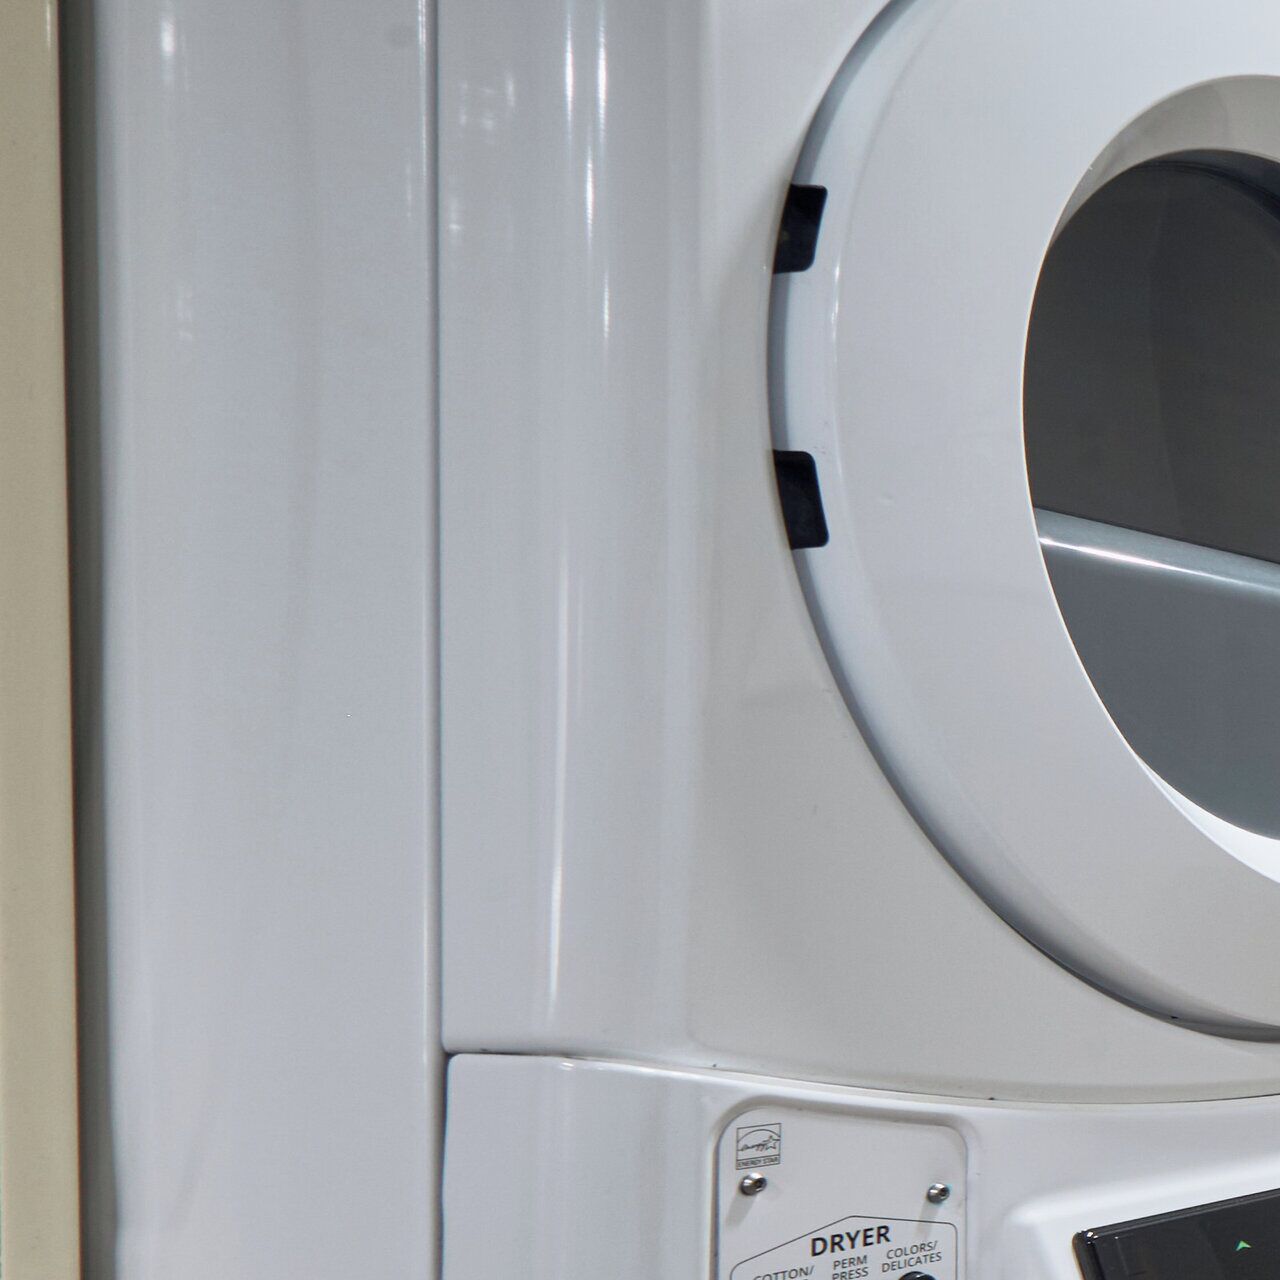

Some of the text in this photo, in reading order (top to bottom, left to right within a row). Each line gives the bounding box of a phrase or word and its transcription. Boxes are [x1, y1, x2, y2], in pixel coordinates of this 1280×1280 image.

[811, 1225, 891, 1257] DRYER
[886, 1240, 938, 1260] COLORS/
[833, 1255, 868, 1271] PERM
[881, 1252, 942, 1273] DELICATES
